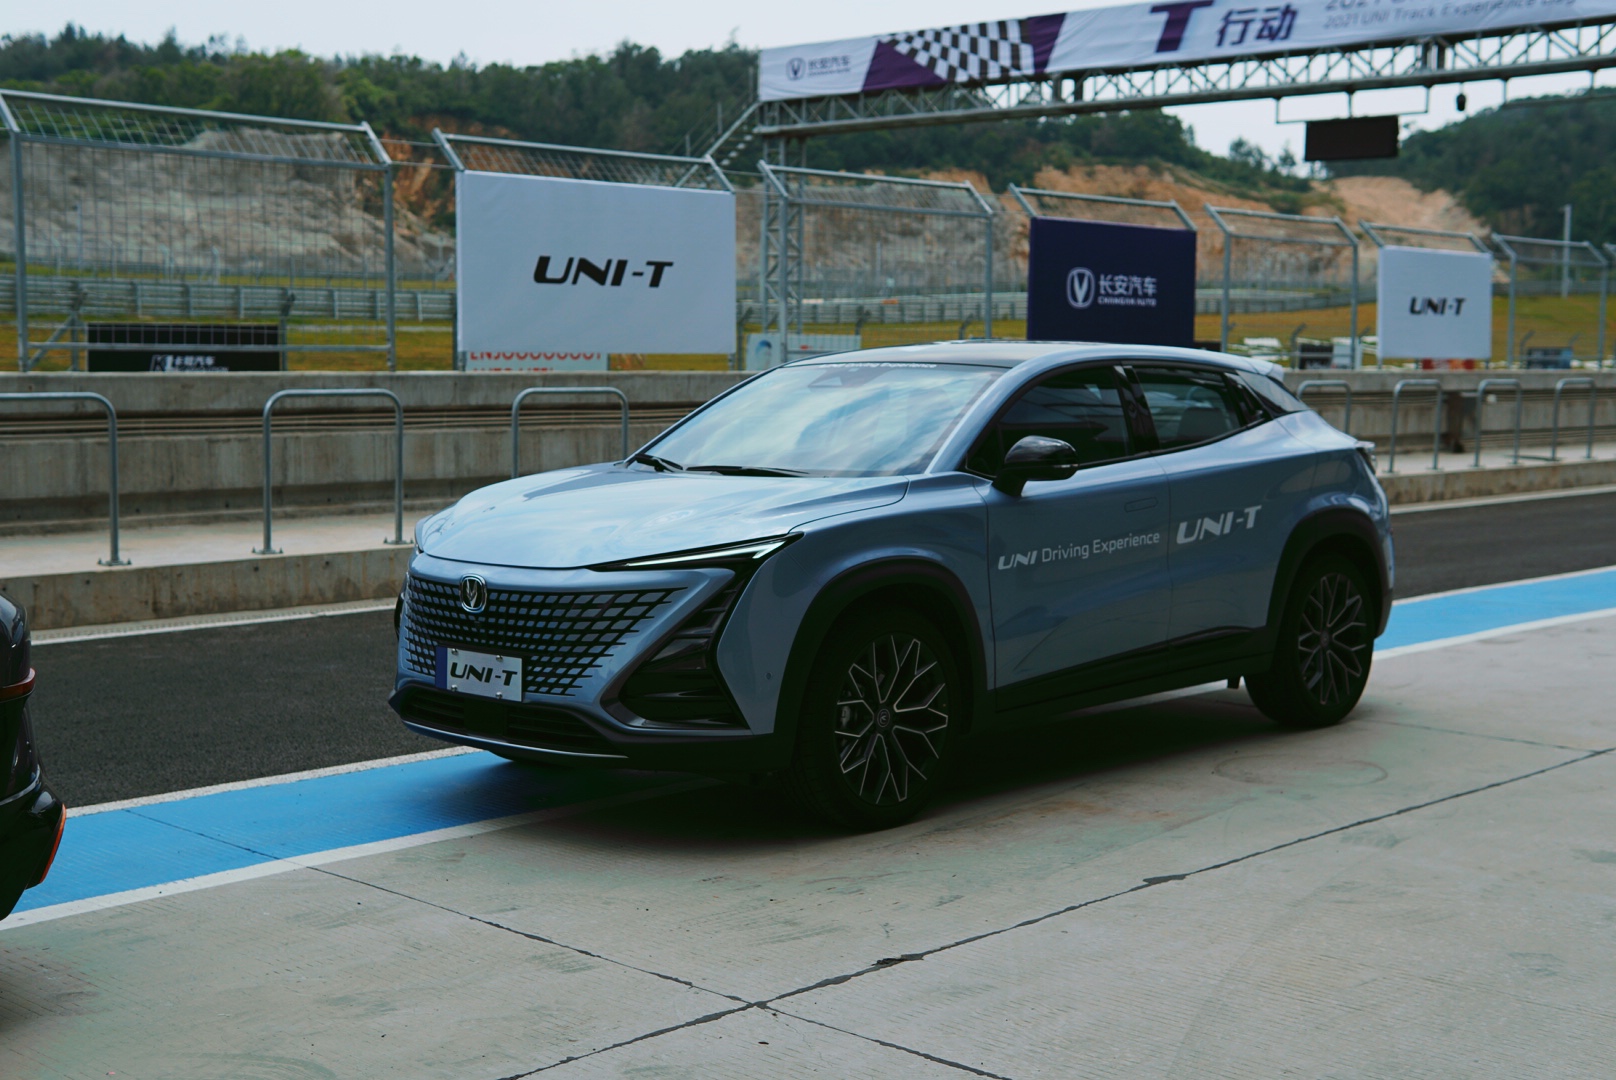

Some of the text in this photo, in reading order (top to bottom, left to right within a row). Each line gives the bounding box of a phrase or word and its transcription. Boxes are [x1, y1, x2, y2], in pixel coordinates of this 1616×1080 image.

[1216, 4, 1298, 47] 行动
[533, 255, 674, 288] UNI-T
[1098, 274, 1157, 296] 长安汽车
[1409, 296, 1466, 316] UNI-T
[1176, 505, 1262, 544] UNI-T
[998, 532, 1160, 570] UNI Driving Experience
[450, 662, 518, 686] UNI-T
